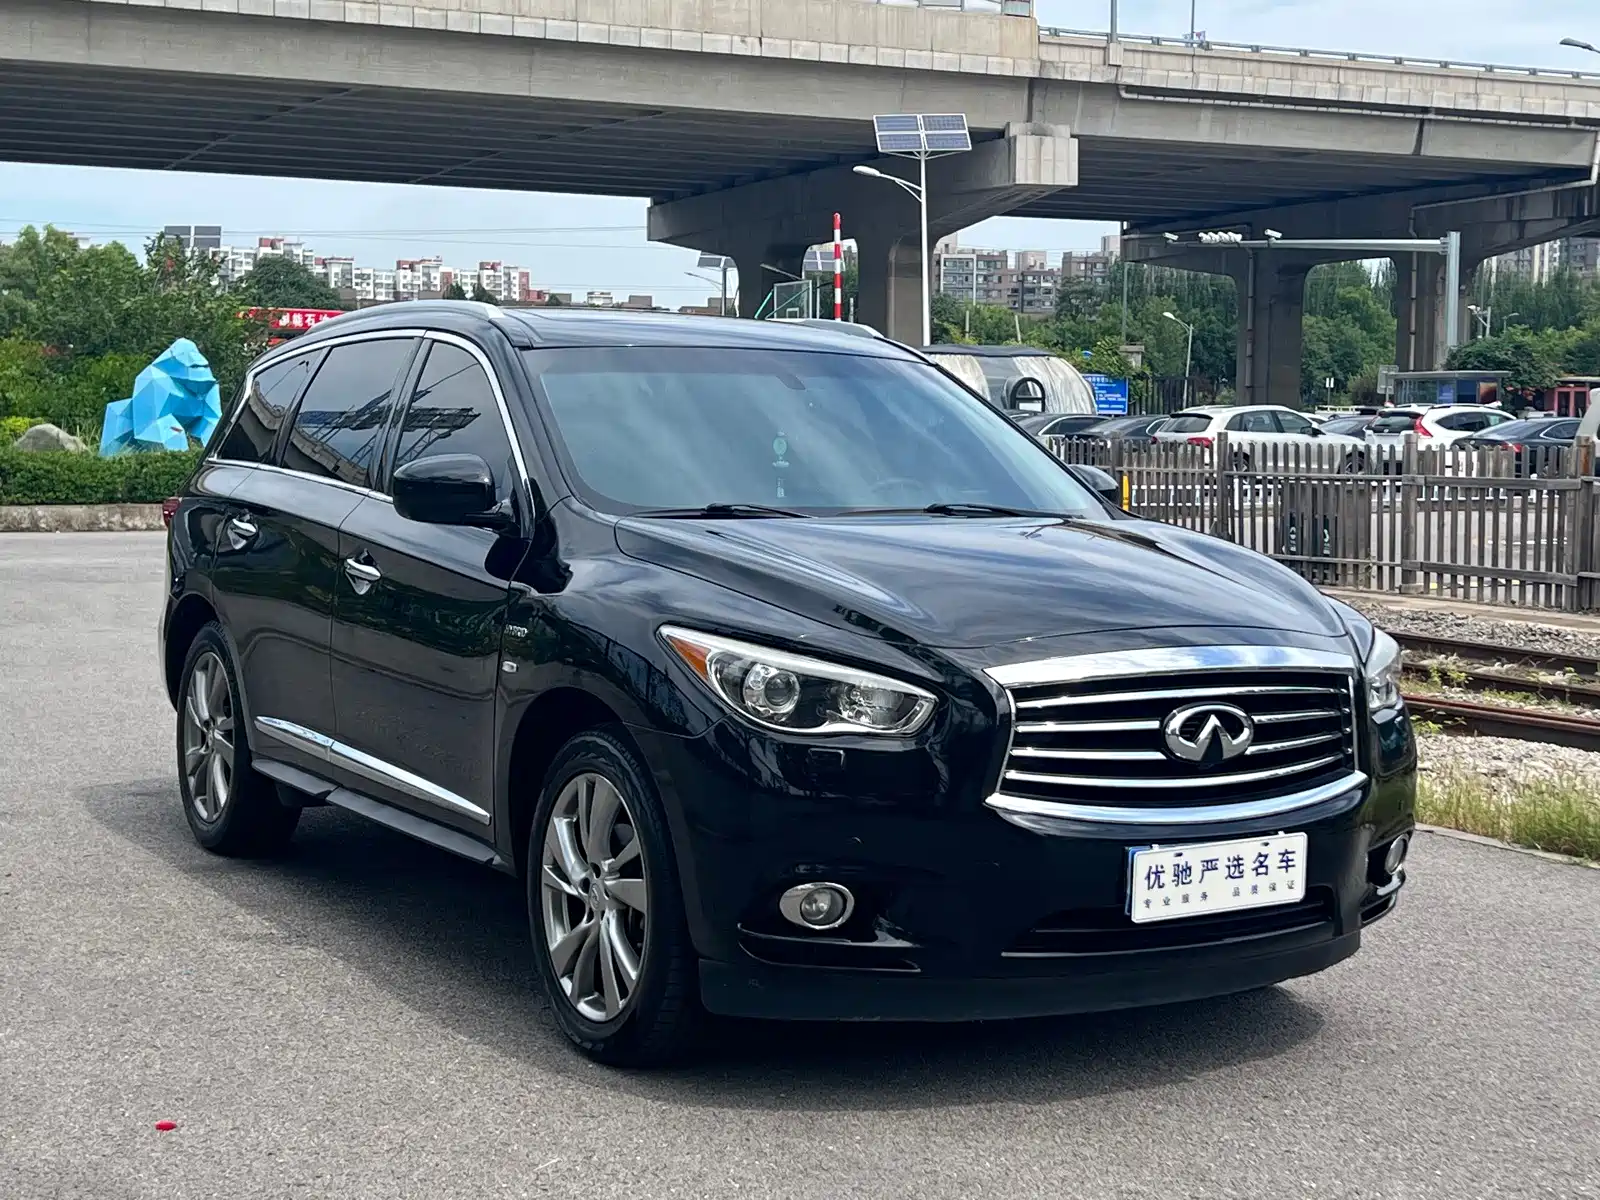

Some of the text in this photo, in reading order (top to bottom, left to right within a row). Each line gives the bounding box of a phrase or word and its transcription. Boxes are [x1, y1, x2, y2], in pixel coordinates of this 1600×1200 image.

[1144, 848, 1296, 891] 优驰严选名车
[1143, 880, 1295, 909] 专业服务 品质保证
